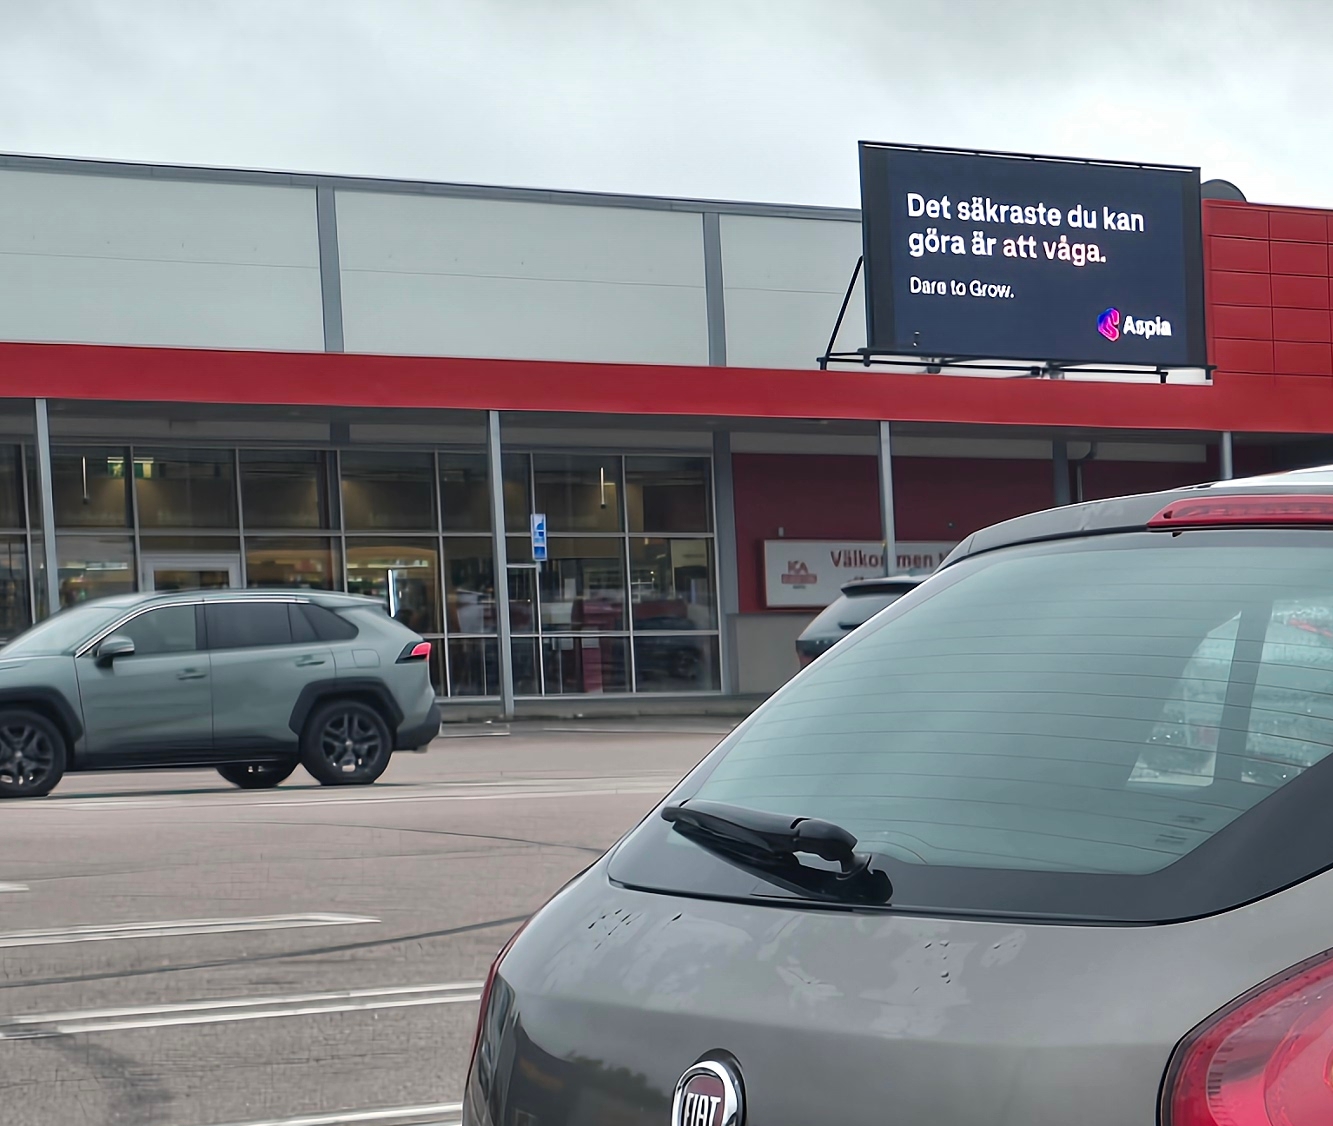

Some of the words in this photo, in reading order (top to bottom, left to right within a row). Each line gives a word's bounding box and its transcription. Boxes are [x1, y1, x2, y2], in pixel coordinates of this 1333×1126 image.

[907, 192, 951, 219] Det
[957, 196, 1062, 227] säkraste
[1067, 204, 1097, 229] du
[1103, 206, 1144, 232] kan
[908, 227, 966, 257] göra
[971, 230, 997, 256] är
[1002, 234, 1038, 259] att
[1043, 234, 1107, 267] våga.
[910, 276, 946, 295] Dare
[950, 279, 966, 297] to
[969, 279, 1015, 298] Grow.
[1122, 315, 1172, 339] Aspia
[830, 549, 933, 569] Välkomen
